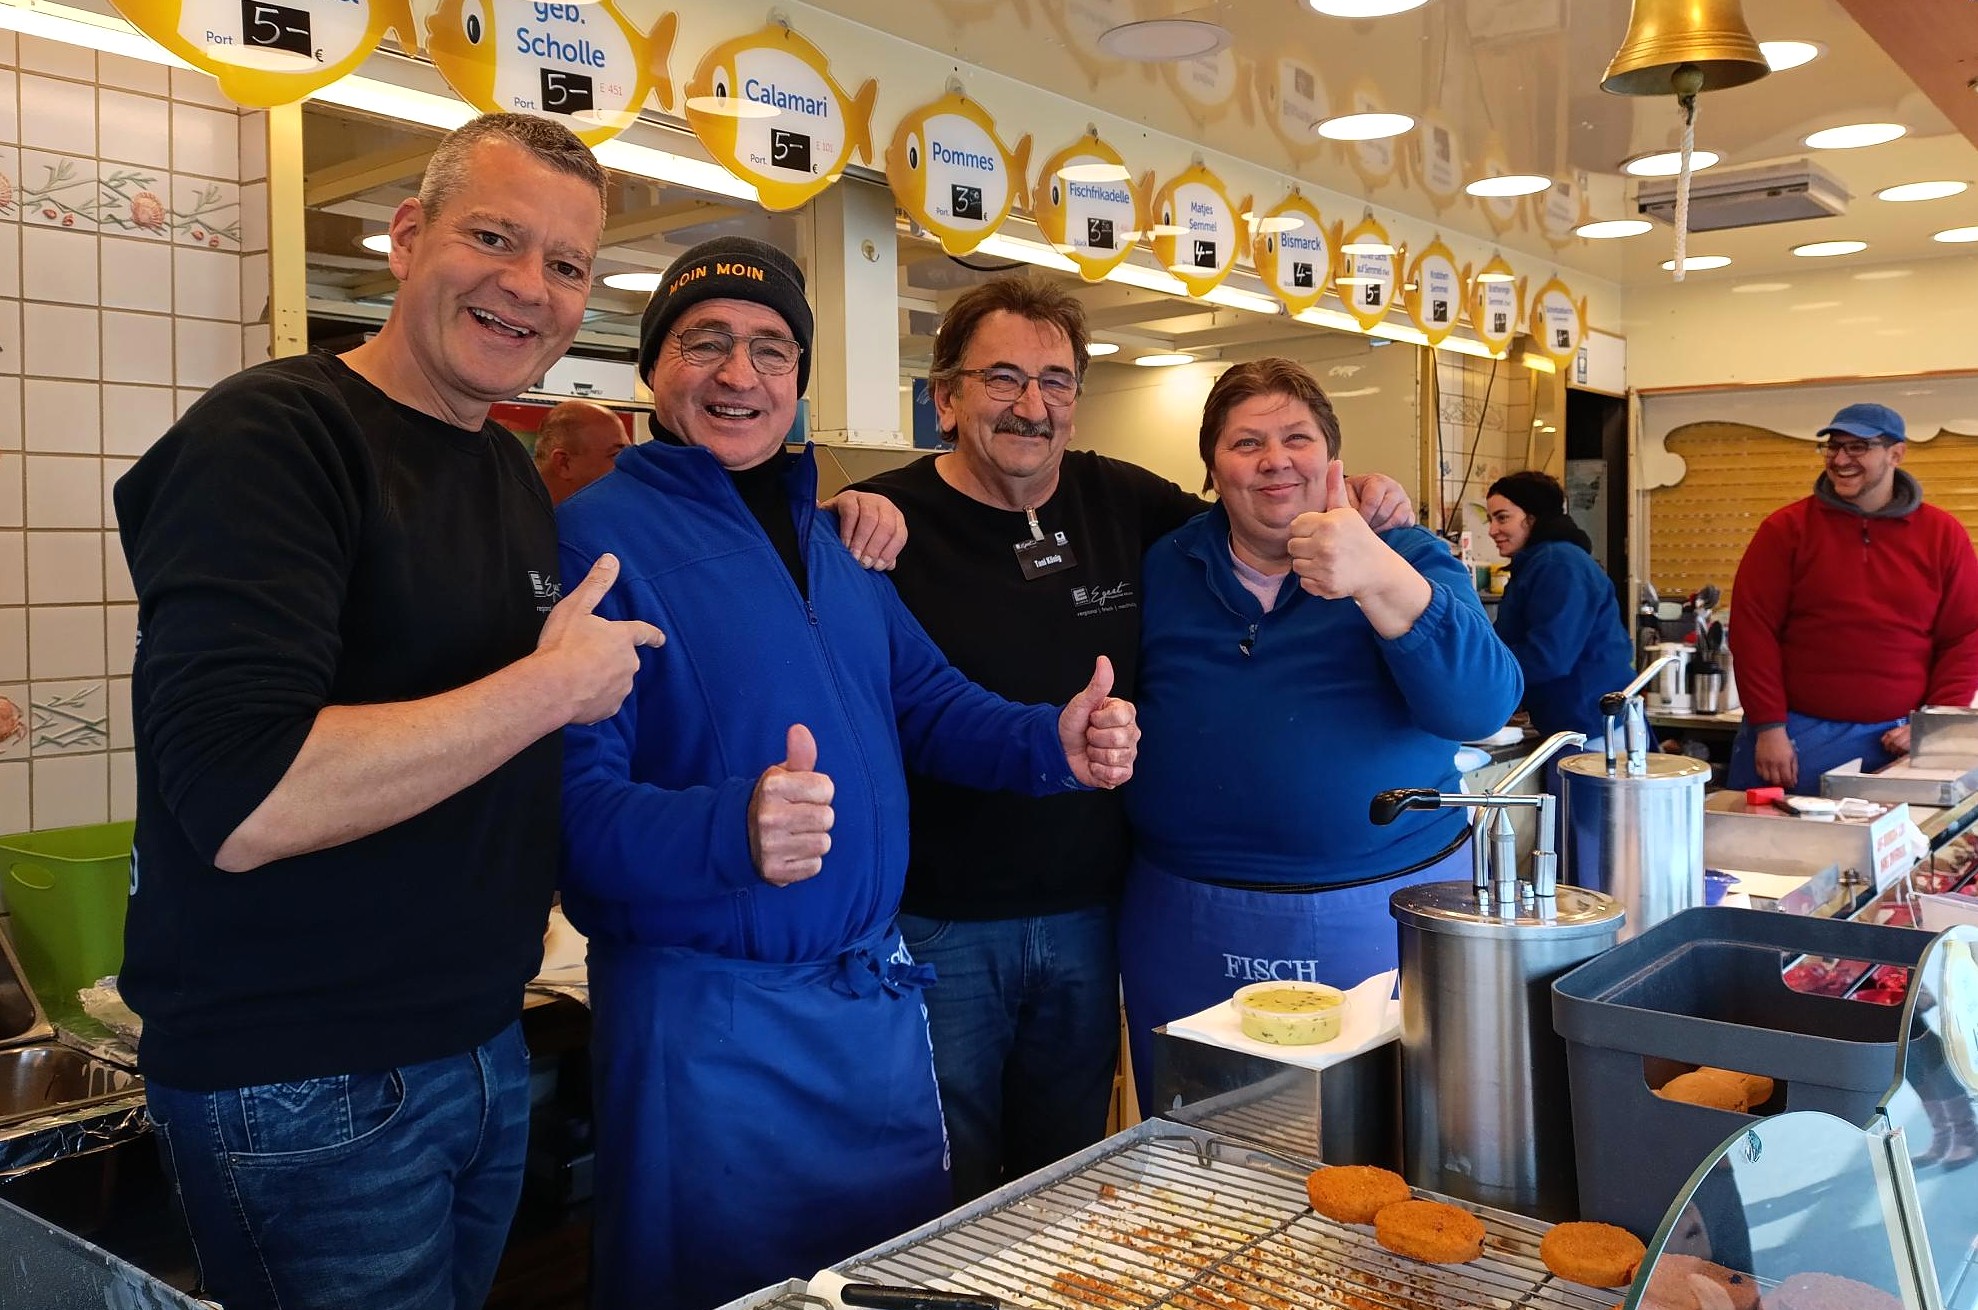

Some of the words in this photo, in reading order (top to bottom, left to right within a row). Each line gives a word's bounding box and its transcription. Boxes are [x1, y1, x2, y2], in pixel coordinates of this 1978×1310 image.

[516, 27, 606, 68] Scholle
[745, 78, 828, 118] Calamari
[933, 141, 995, 171] Pommes
[1069, 182, 1131, 204] Fischfrikadelle
[1190, 201, 1214, 216] Matjes
[1189, 218, 1218, 232] Semmel
[1281, 231, 1321, 251] Bismarck
[668, 266, 707, 296] MOIN
[716, 262, 765, 282] MOIN
[1222, 953, 1319, 984] FISCH
